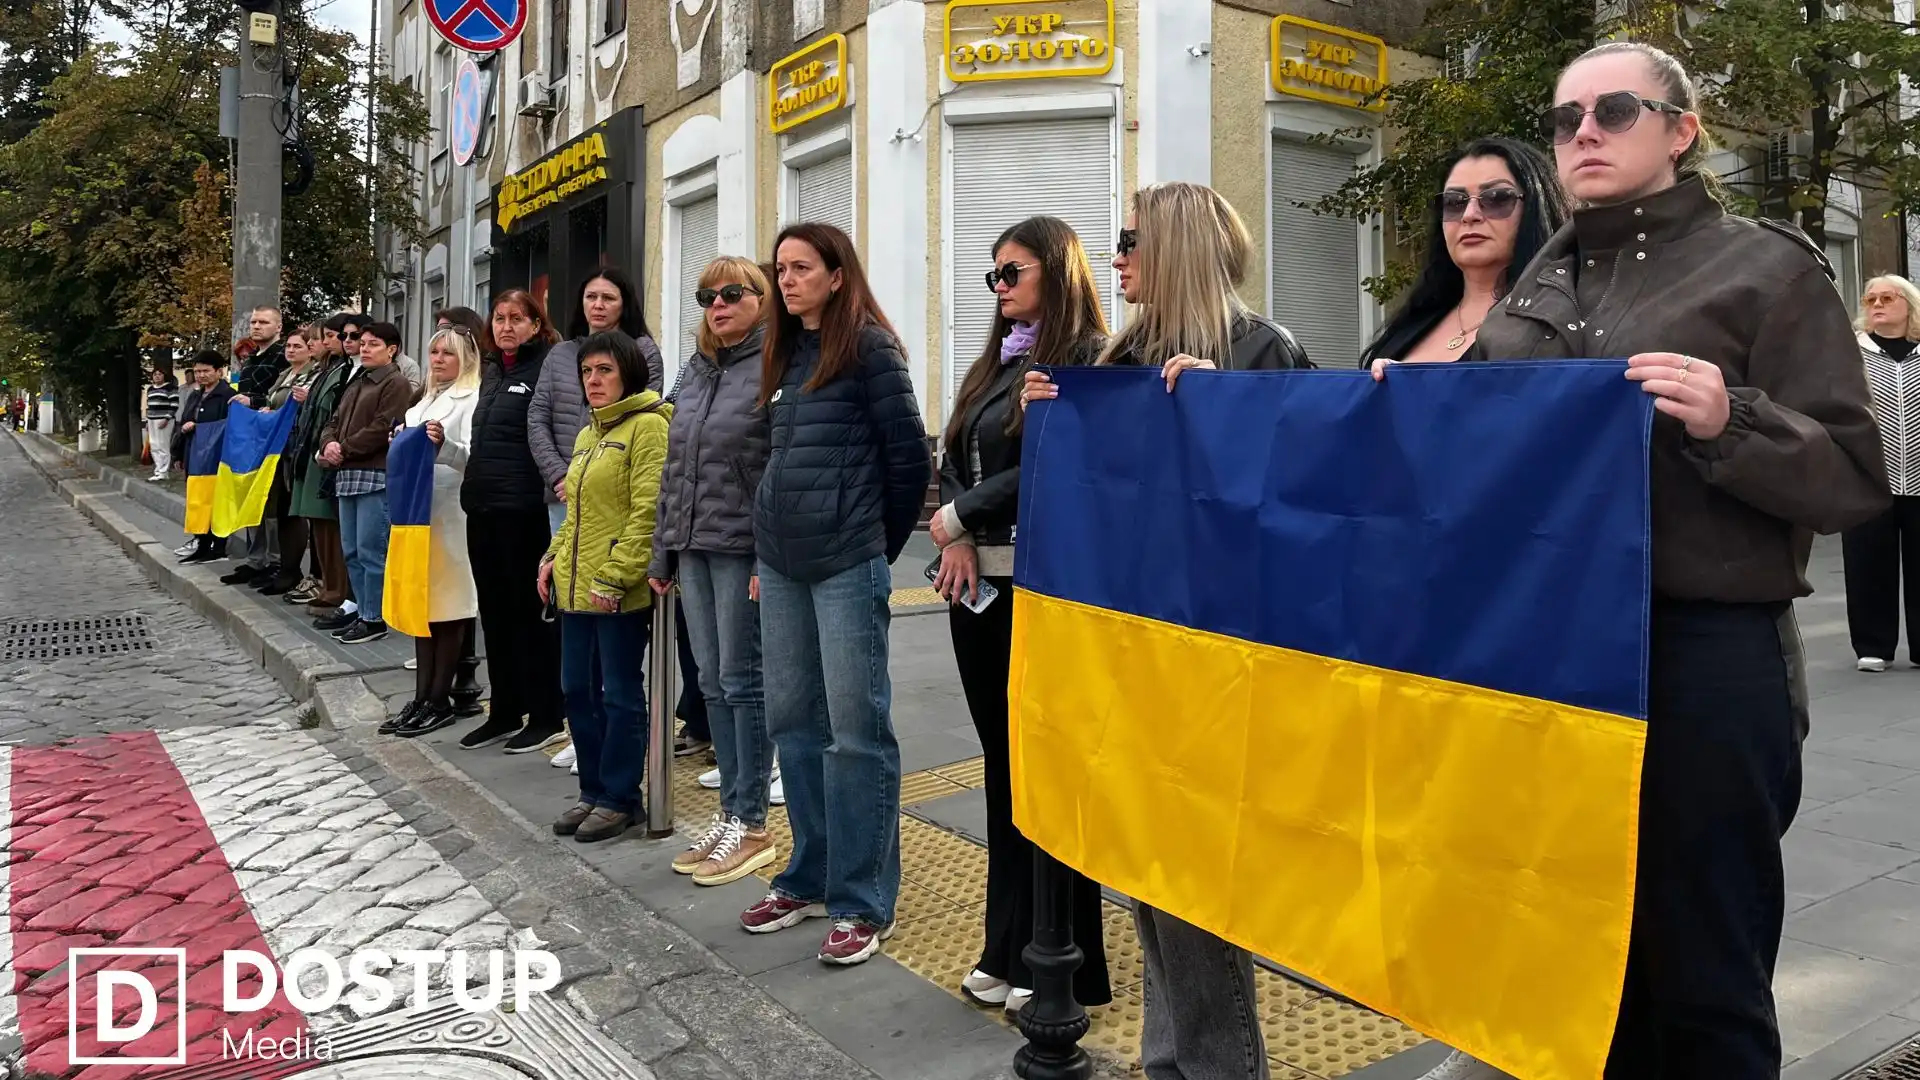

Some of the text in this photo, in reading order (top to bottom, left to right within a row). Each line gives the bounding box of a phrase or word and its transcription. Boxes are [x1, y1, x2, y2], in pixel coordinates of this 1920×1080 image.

[992, 13, 1063, 36] УКР
[952, 37, 1106, 64] ЗОЛОТО
[1306, 40, 1357, 65] УКР
[789, 60, 825, 87] УКР
[772, 76, 839, 118] ЗОЛОТО
[517, 132, 607, 200] СТОЛИЧНА
